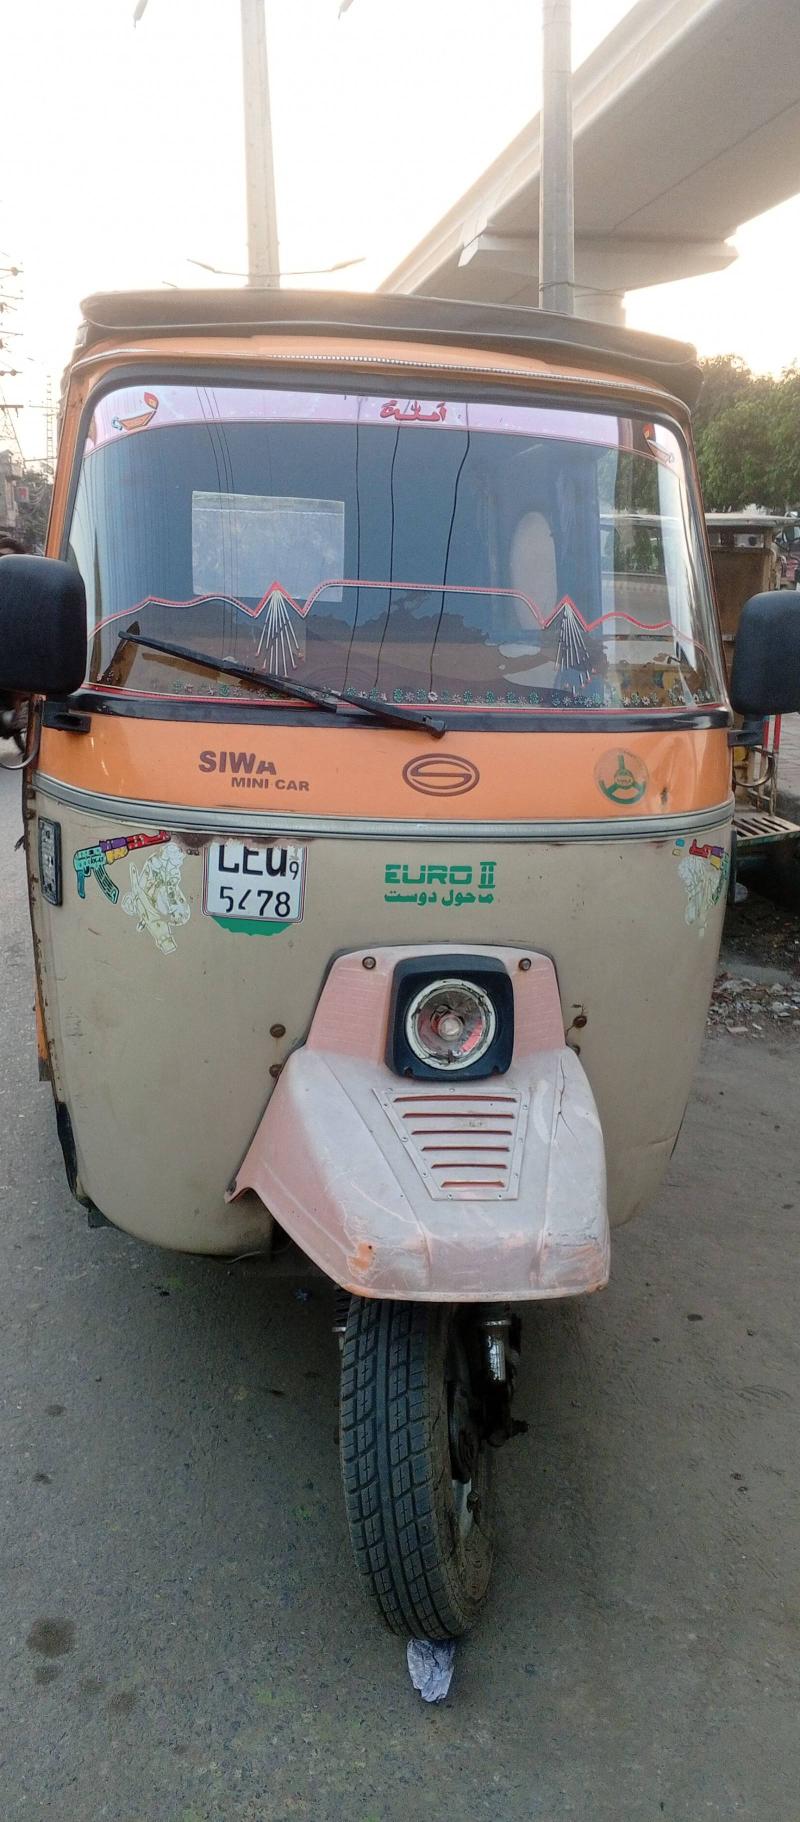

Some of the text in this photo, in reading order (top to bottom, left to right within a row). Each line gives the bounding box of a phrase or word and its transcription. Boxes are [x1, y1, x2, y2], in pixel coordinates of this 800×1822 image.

[231, 777, 310, 792] MINI CAR
[384, 864, 472, 885] EURO
